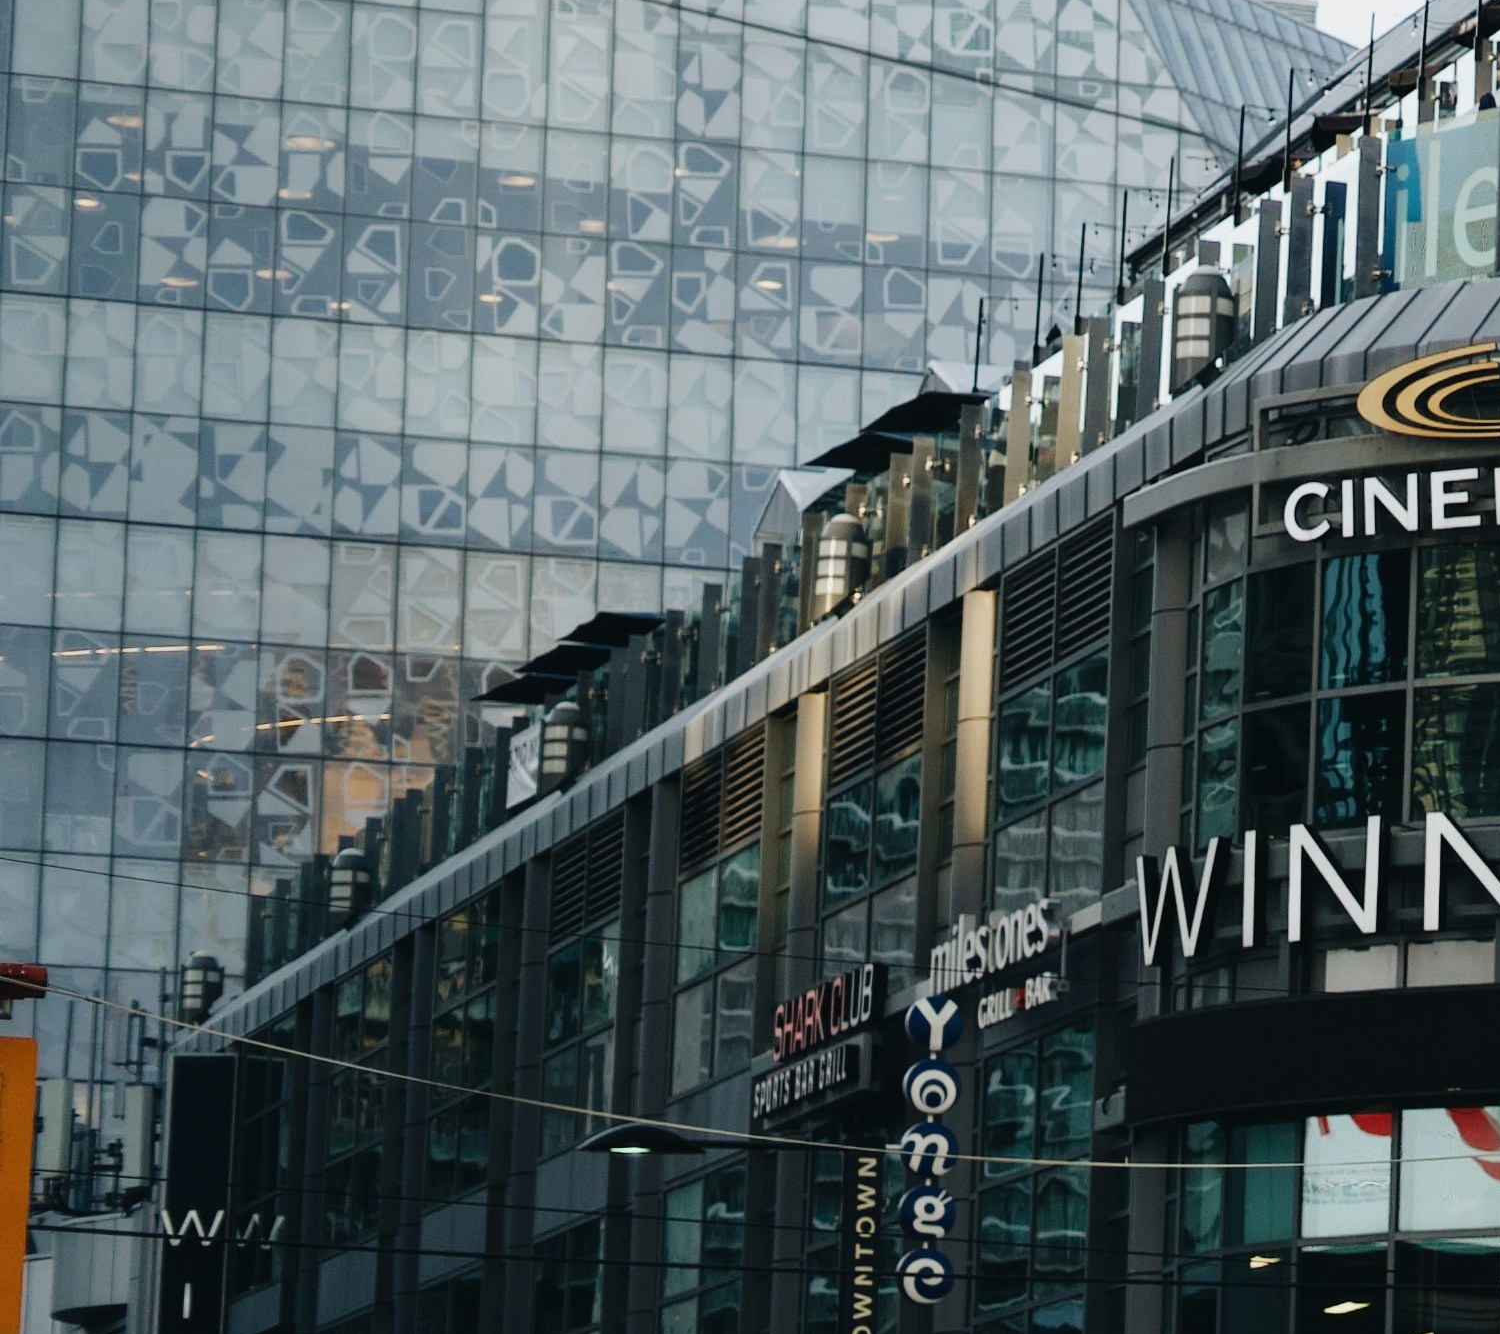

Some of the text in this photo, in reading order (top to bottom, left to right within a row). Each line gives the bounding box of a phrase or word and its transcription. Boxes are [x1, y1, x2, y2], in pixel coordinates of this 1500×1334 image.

[929, 898, 1050, 997] milestones
[773, 963, 875, 1062] SHARK CLUB
[977, 971, 1052, 1030] GRILL BAR
[753, 1051, 849, 1120] SPORTS BAR GRILL
